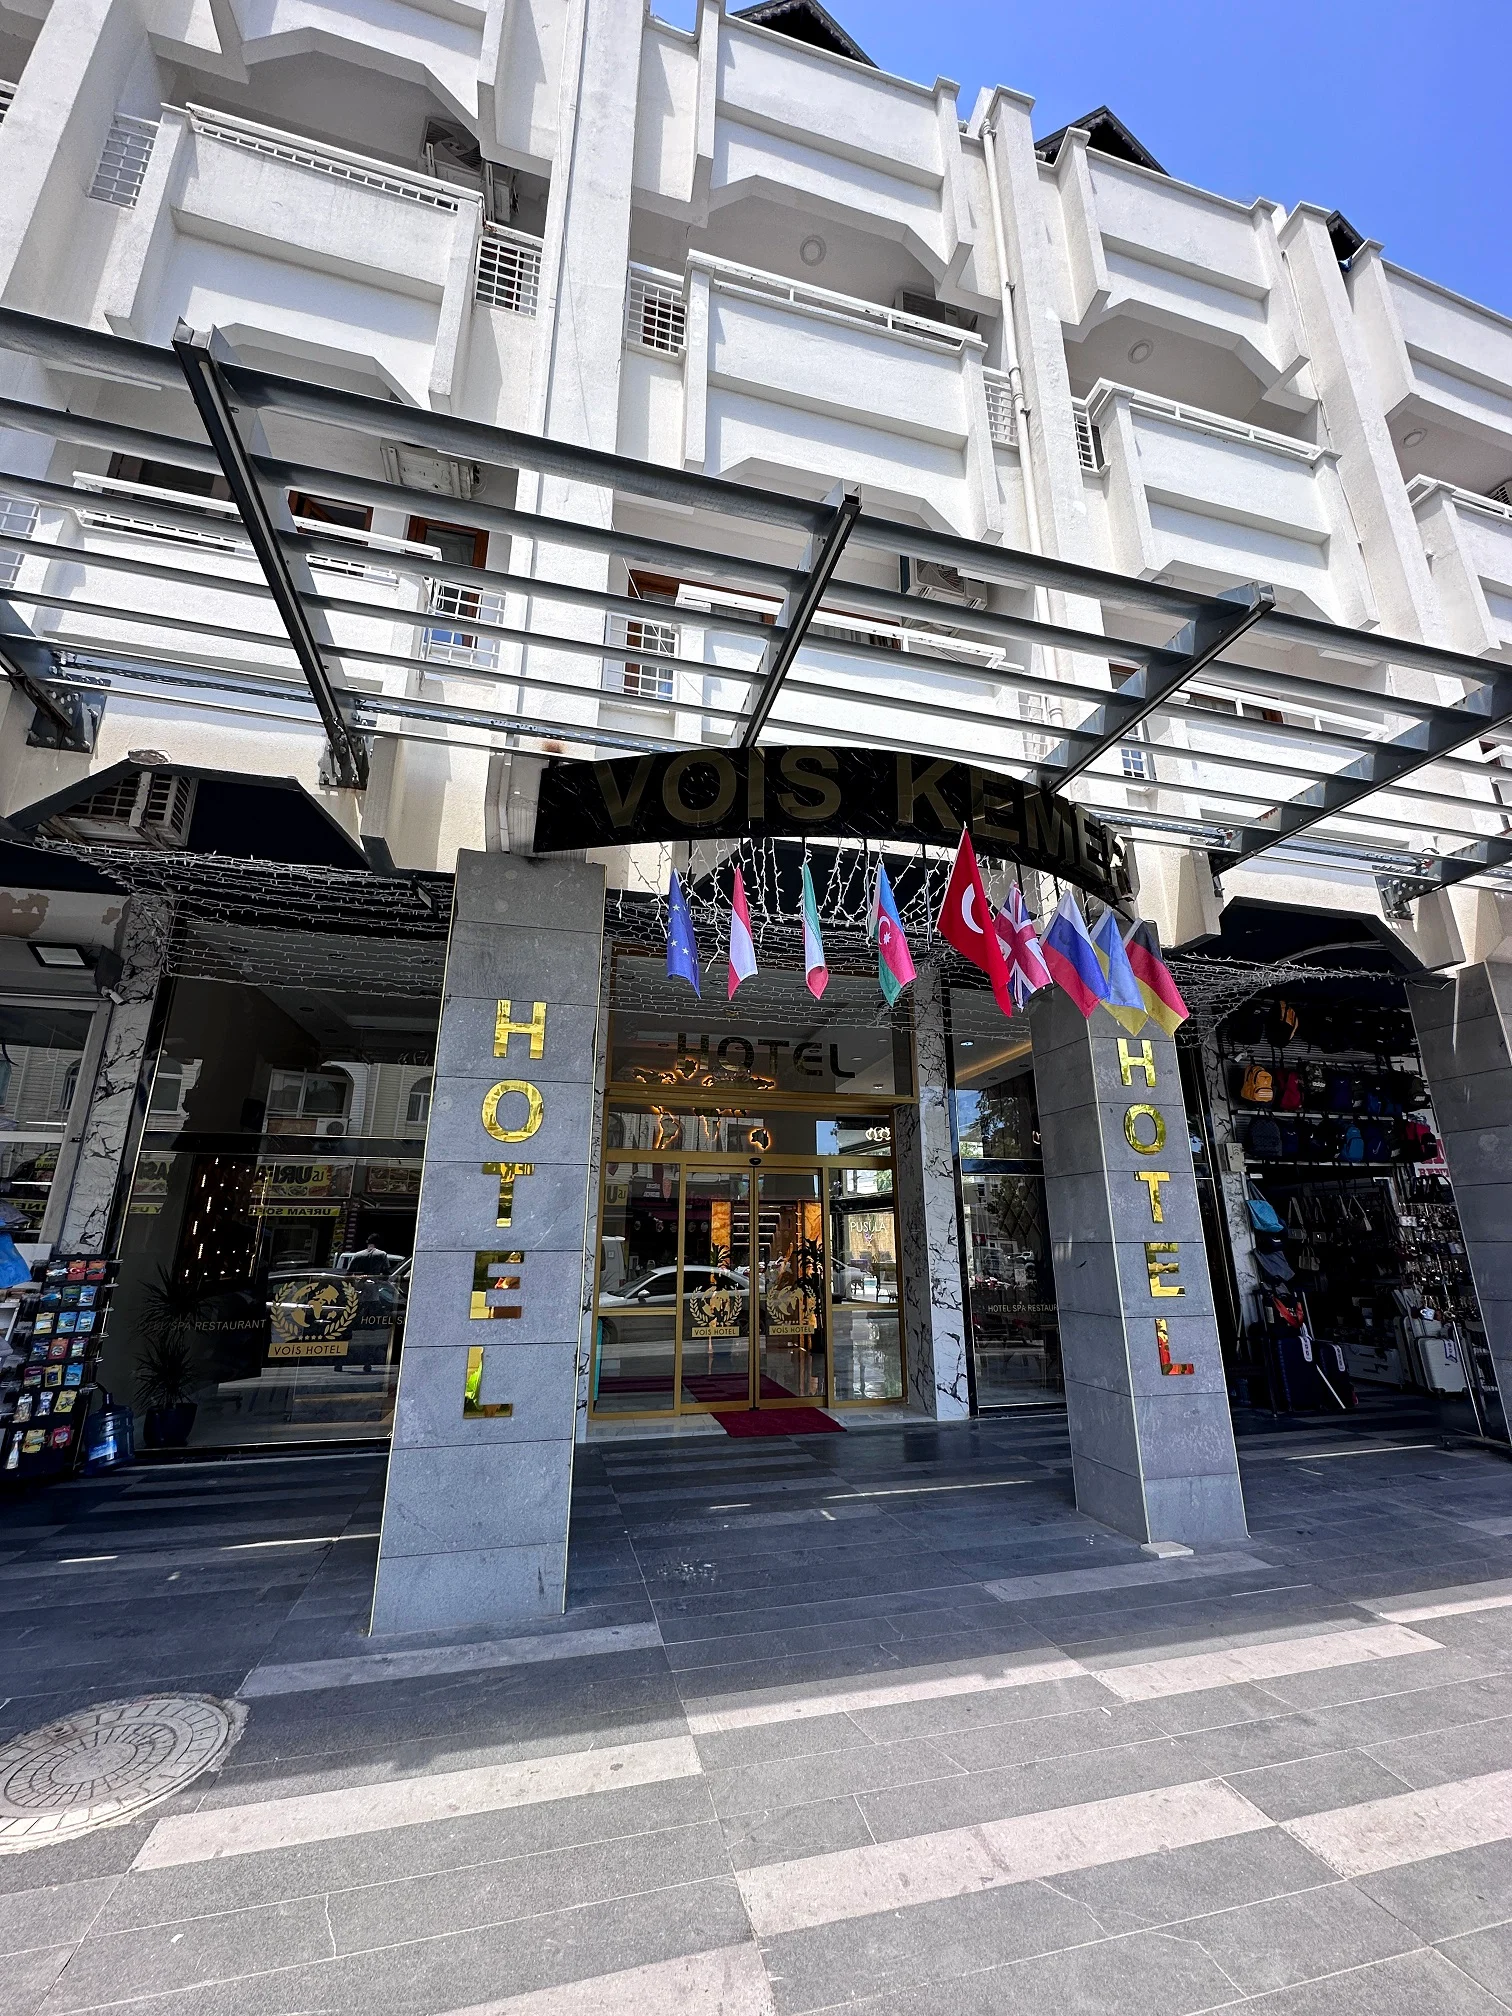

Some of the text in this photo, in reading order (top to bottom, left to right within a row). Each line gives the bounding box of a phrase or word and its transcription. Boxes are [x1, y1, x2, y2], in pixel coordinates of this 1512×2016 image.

[593, 746, 1140, 901] VOIS KEMER
[676, 1032, 856, 1078] HOTEL
[463, 999, 547, 1419] HOTEL
[1116, 1037, 1195, 1376] HOTEL
[850, 1221, 887, 1233] PUSULA
[988, 1304, 1011, 1313] HOTEL
[1012, 1304, 1027, 1312] SPA
[194, 1319, 267, 1331] RESTAURANT
[360, 1315, 394, 1325] HOTEL
[714, 1328, 736, 1336] HOTEL
[790, 1326, 812, 1334] HOTEL
[274, 1343, 341, 1356] VOİS HOTEL
